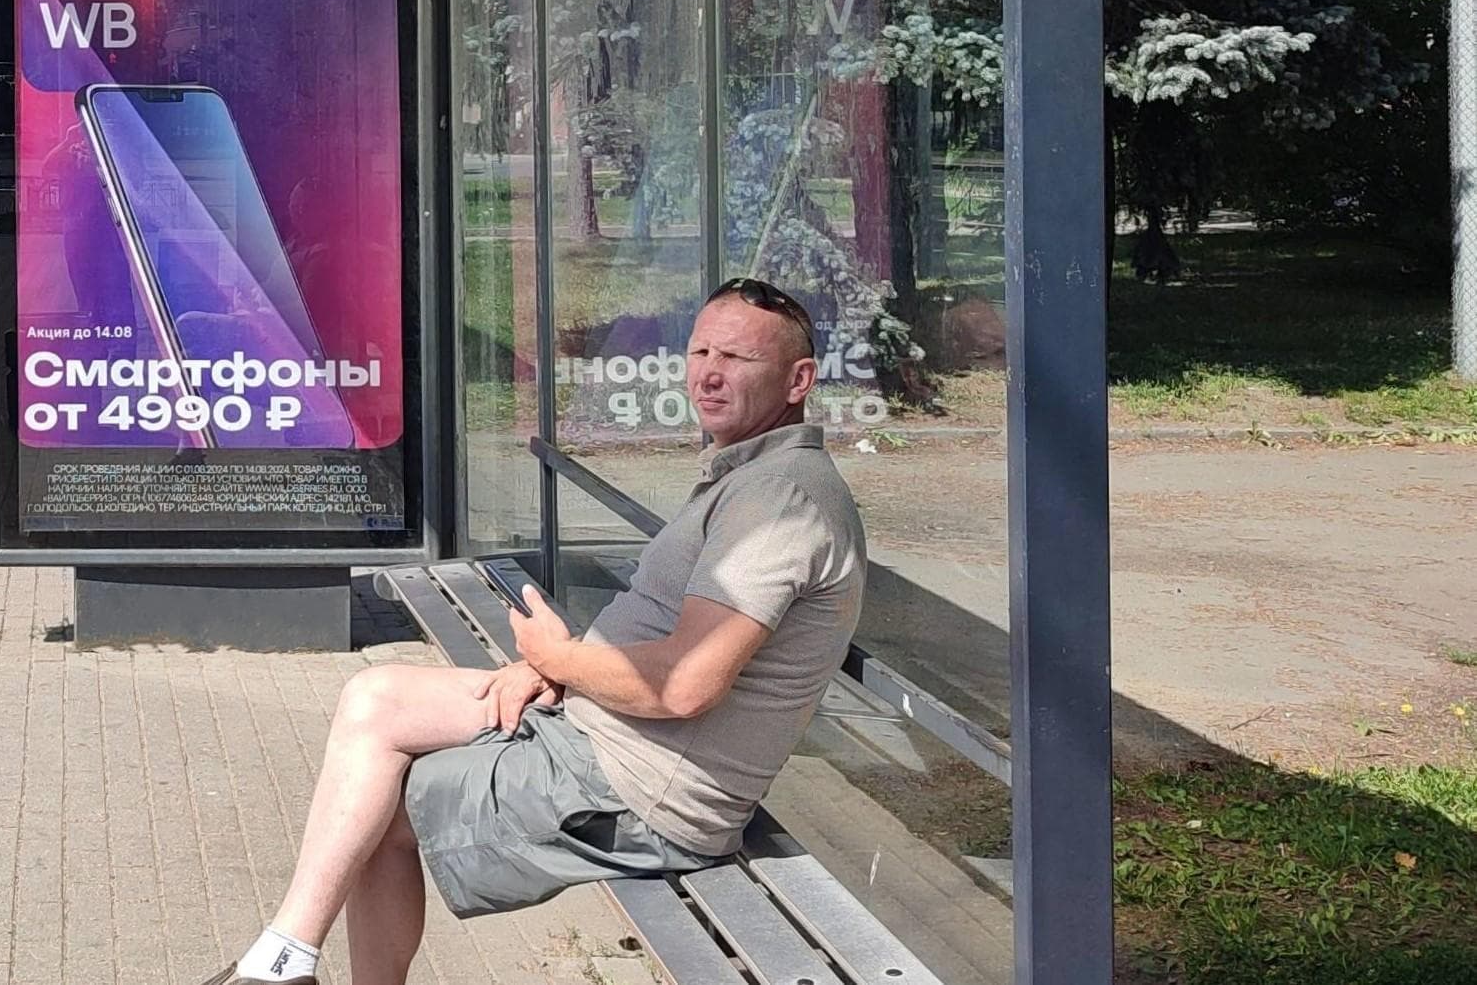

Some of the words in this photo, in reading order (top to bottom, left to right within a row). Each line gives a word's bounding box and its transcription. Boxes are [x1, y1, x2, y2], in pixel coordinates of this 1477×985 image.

[39, 2, 137, 49] WB
[26, 326, 70, 340] Акция
[72, 328, 92, 340] до
[94, 326, 133, 339] 14.08
[24, 351, 381, 394] Смартфоны
[24, 402, 87, 431] от
[97, 395, 252, 432] 4990
[266, 396, 302, 431] ₽
[53, 464, 78, 474] СРОК
[80, 464, 140, 474] ПРОВЕДЕНИЯ
[142, 464, 174, 474] АКЦИИ
[175, 464, 182, 474] С
[230, 464, 243, 474] ПО
[292, 464, 322, 474] ТОВАР
[324, 464, 362, 474] МОЖНО
[47, 474, 108, 483] ПРИОБРЕСТИ
[110, 474, 123, 483] ПО
[125, 474, 157, 483] АКЦИИ
[159, 474, 195, 483] ТОЛЬКО
[196, 474, 215, 483] ПРИ
[265, 474, 283, 483] ЧТО
[285, 474, 315, 483] ТОВАР
[316, 474, 360, 483] ИМЕЕТСЯ
[361, 474, 368, 483] В
[97, 484, 142, 493] НАЛИЧИЕ
[143, 484, 197, 493] УТОЧНЯЙТЕ
[198, 484, 211, 493] НА
[213, 484, 243, 493] САЙТЕ
[345, 484, 367, 493] ООО
[216, 493, 289, 503] ЮРИДИЧЕСКИЙ
[177, 503, 266, 513] ИНДУСТРИАЛЬНЫЙ
[267, 503, 291, 513] ПАРК
